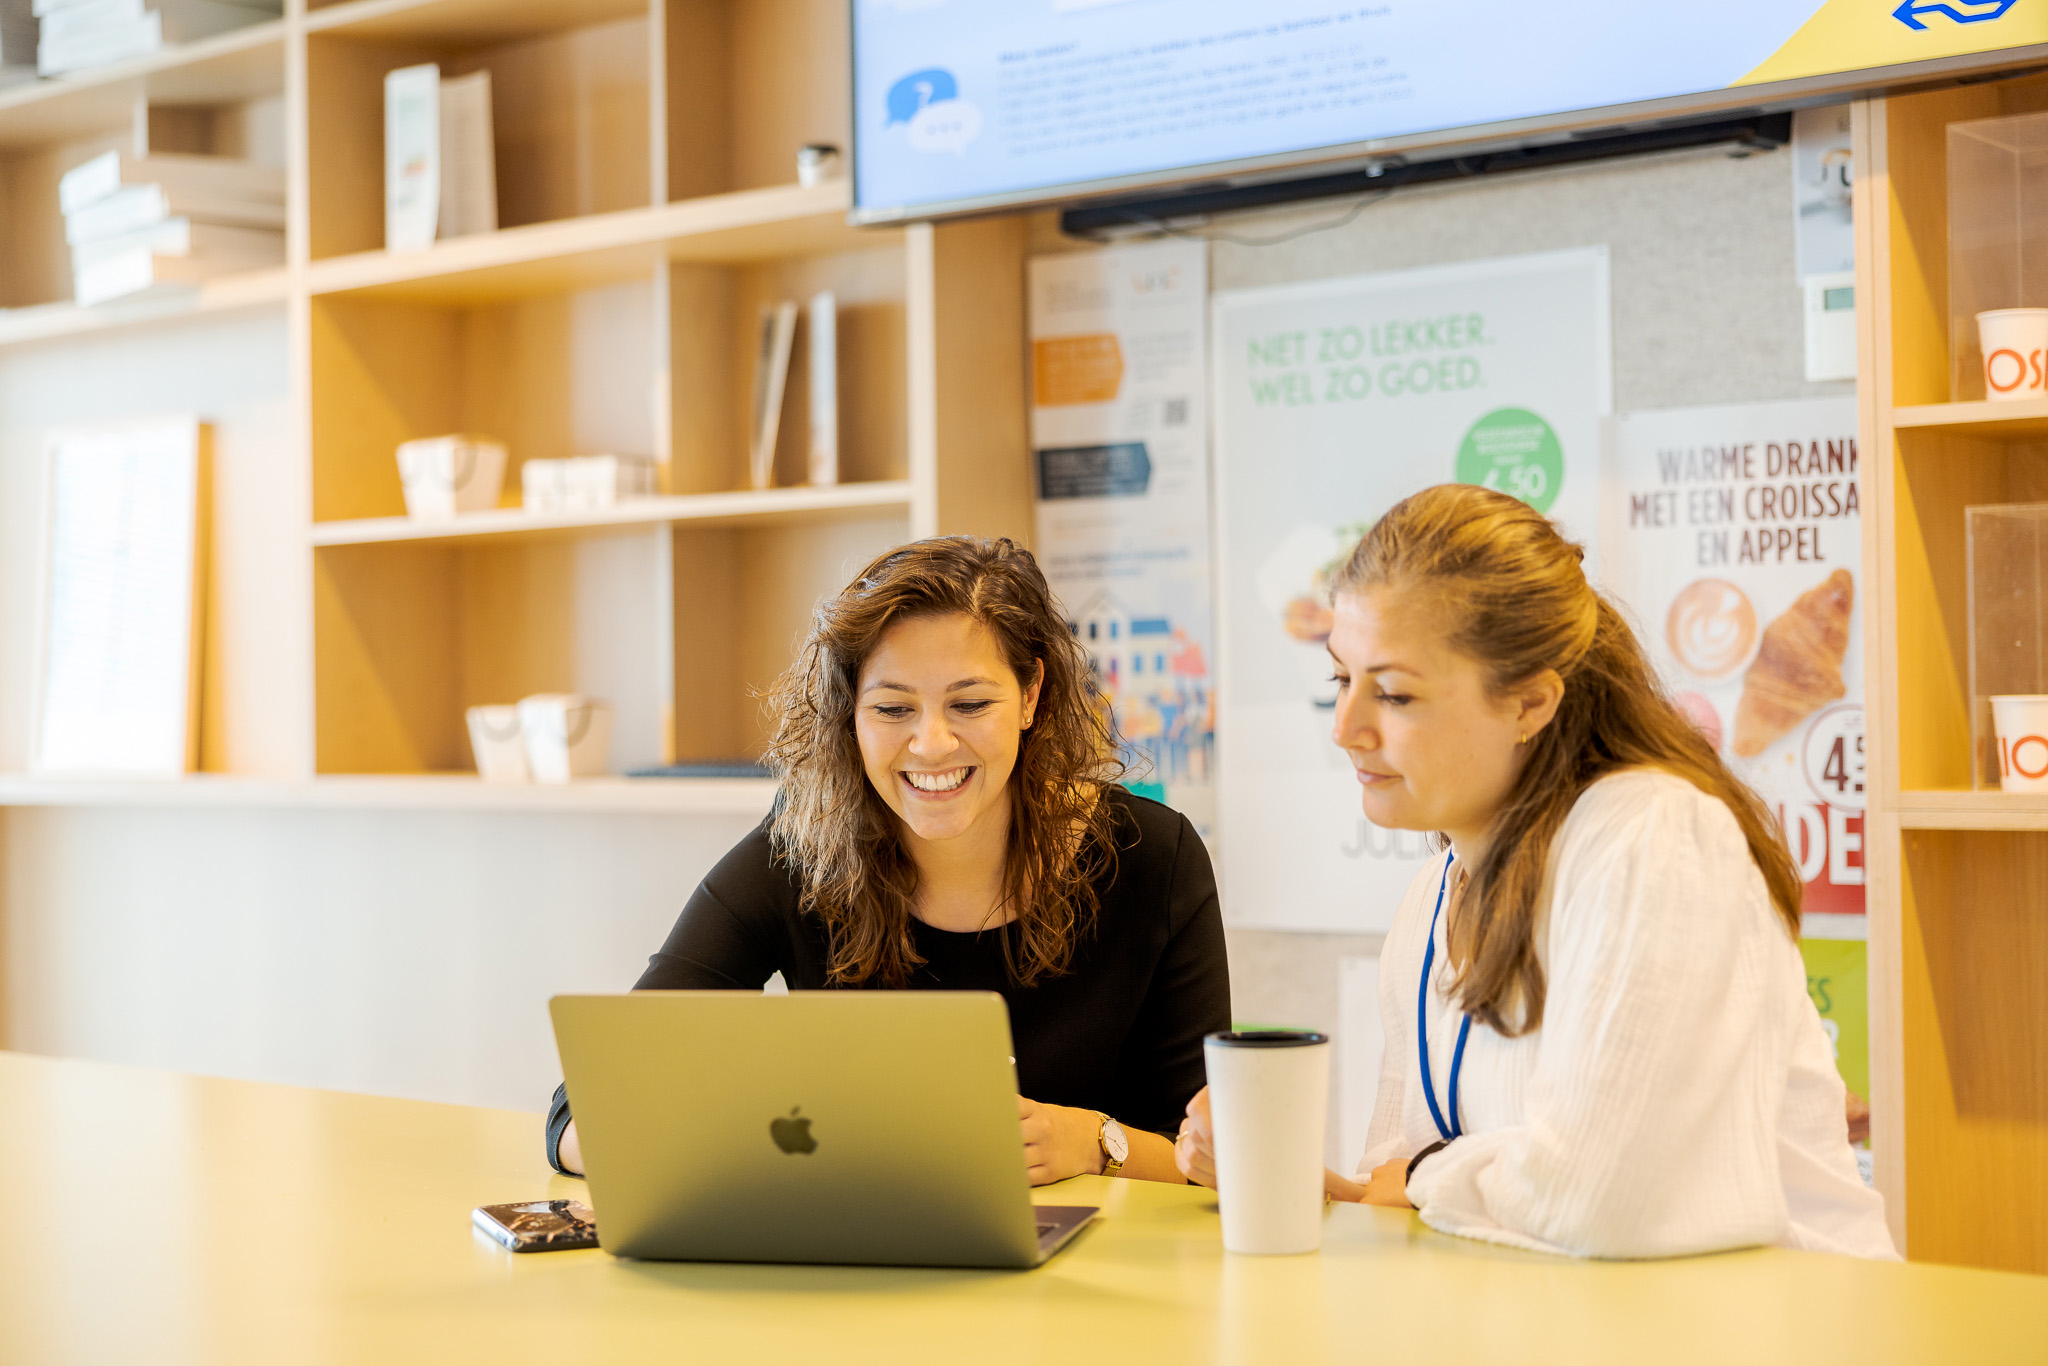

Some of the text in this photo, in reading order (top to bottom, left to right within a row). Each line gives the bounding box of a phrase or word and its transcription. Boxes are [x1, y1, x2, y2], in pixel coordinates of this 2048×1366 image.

[1246, 312, 1495, 368] NET ZO LEKKER.
[1249, 356, 1486, 407] WEL ZO GOED.
[1987, 348, 2048, 393] OS
[1658, 444, 1755, 483] WARME
[1630, 492, 1677, 527] MET
[1688, 488, 1734, 525] EEN
[1697, 526, 1826, 566] EN APPEL
[1998, 734, 2048, 779] IO
[1783, 803, 1864, 885] DE
